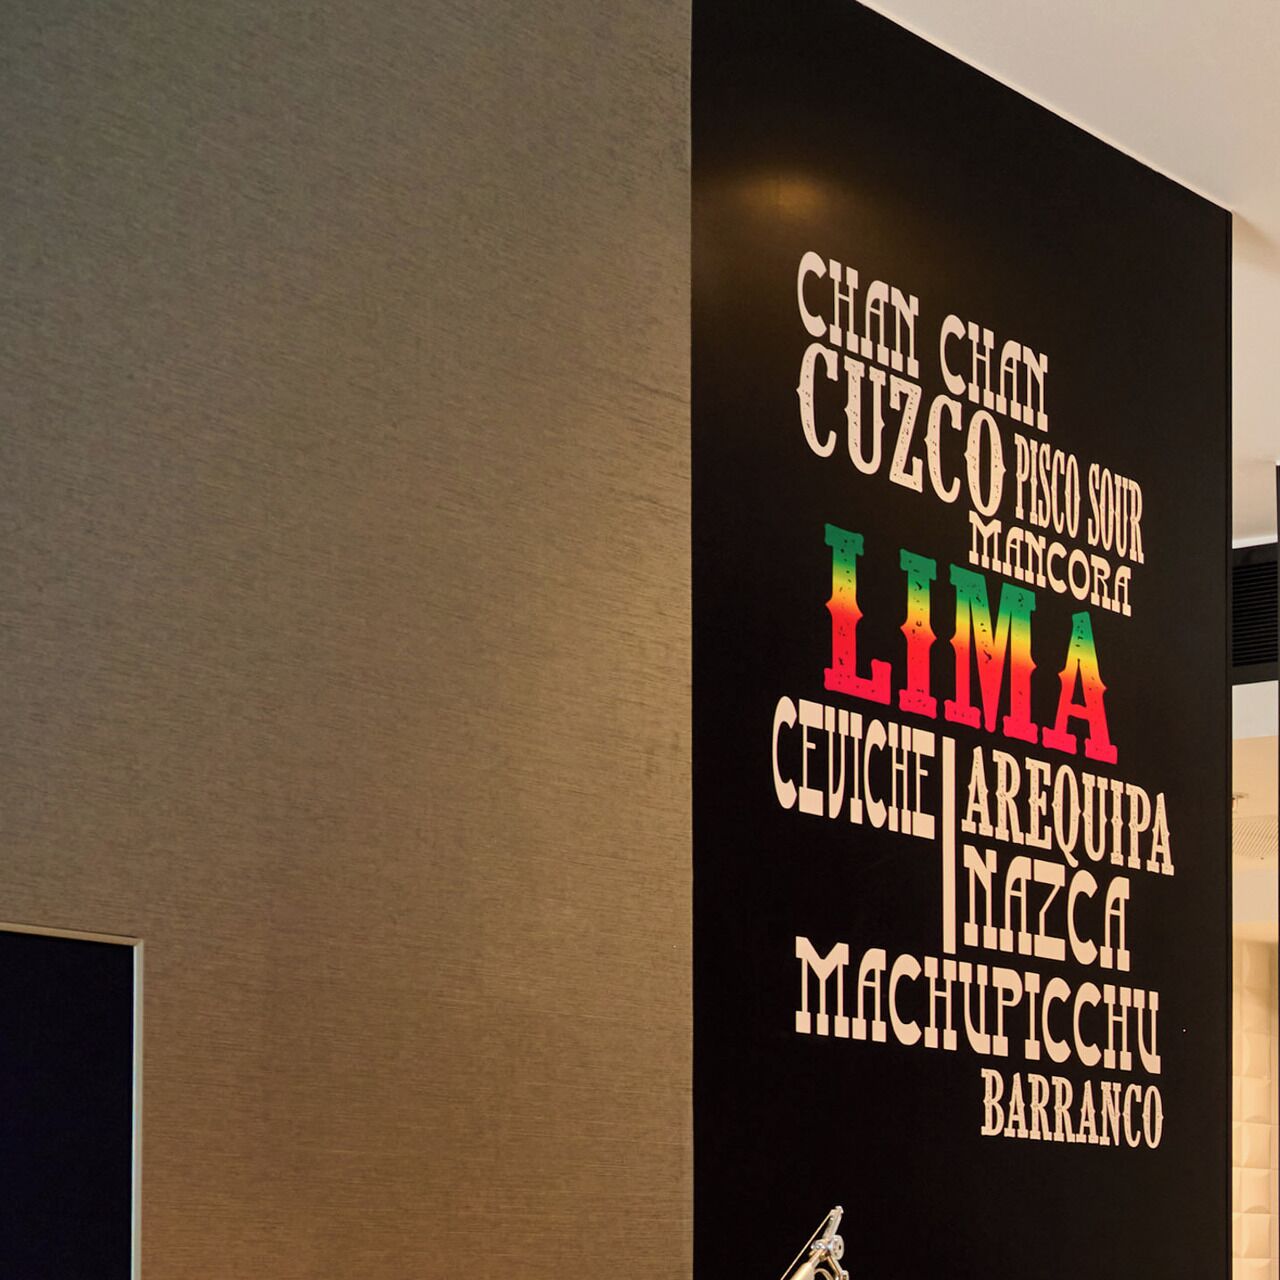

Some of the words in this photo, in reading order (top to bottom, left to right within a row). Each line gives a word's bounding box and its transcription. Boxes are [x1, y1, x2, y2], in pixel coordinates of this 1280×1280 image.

[797, 251, 919, 379] CHAN
[940, 314, 1048, 432] CHAN
[796, 342, 1007, 517] CUZCO
[968, 510, 1132, 617] MANCORA
[1014, 433, 1080, 539] PISCO
[1087, 463, 1145, 564] SOUR
[824, 522, 1118, 764] LIMA
[772, 696, 935, 840] CEVICHE
[961, 745, 1174, 876] AREQUIPA
[964, 844, 1130, 972] NAZCA
[796, 936, 1161, 1075] MACHUPICCHU
[981, 1067, 1164, 1149] BARRANCO
